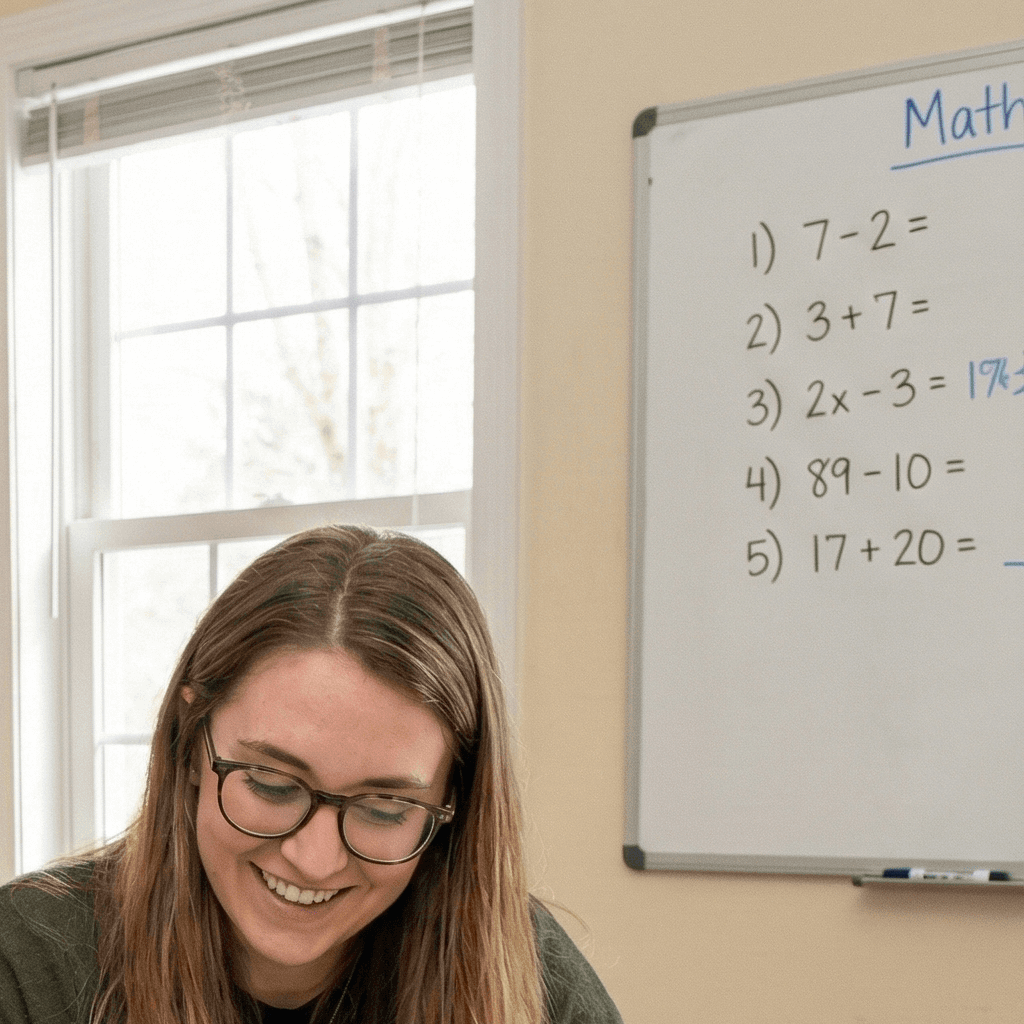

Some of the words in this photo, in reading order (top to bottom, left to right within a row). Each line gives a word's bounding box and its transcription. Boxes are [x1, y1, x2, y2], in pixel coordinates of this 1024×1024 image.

[905, 82, 1024, 149] Math
[751, 221, 776, 276] 1)
[746, 302, 782, 355] 2)
[747, 378, 783, 431] 3)
[745, 456, 782, 510] 4)
[746, 528, 783, 583] 5)
